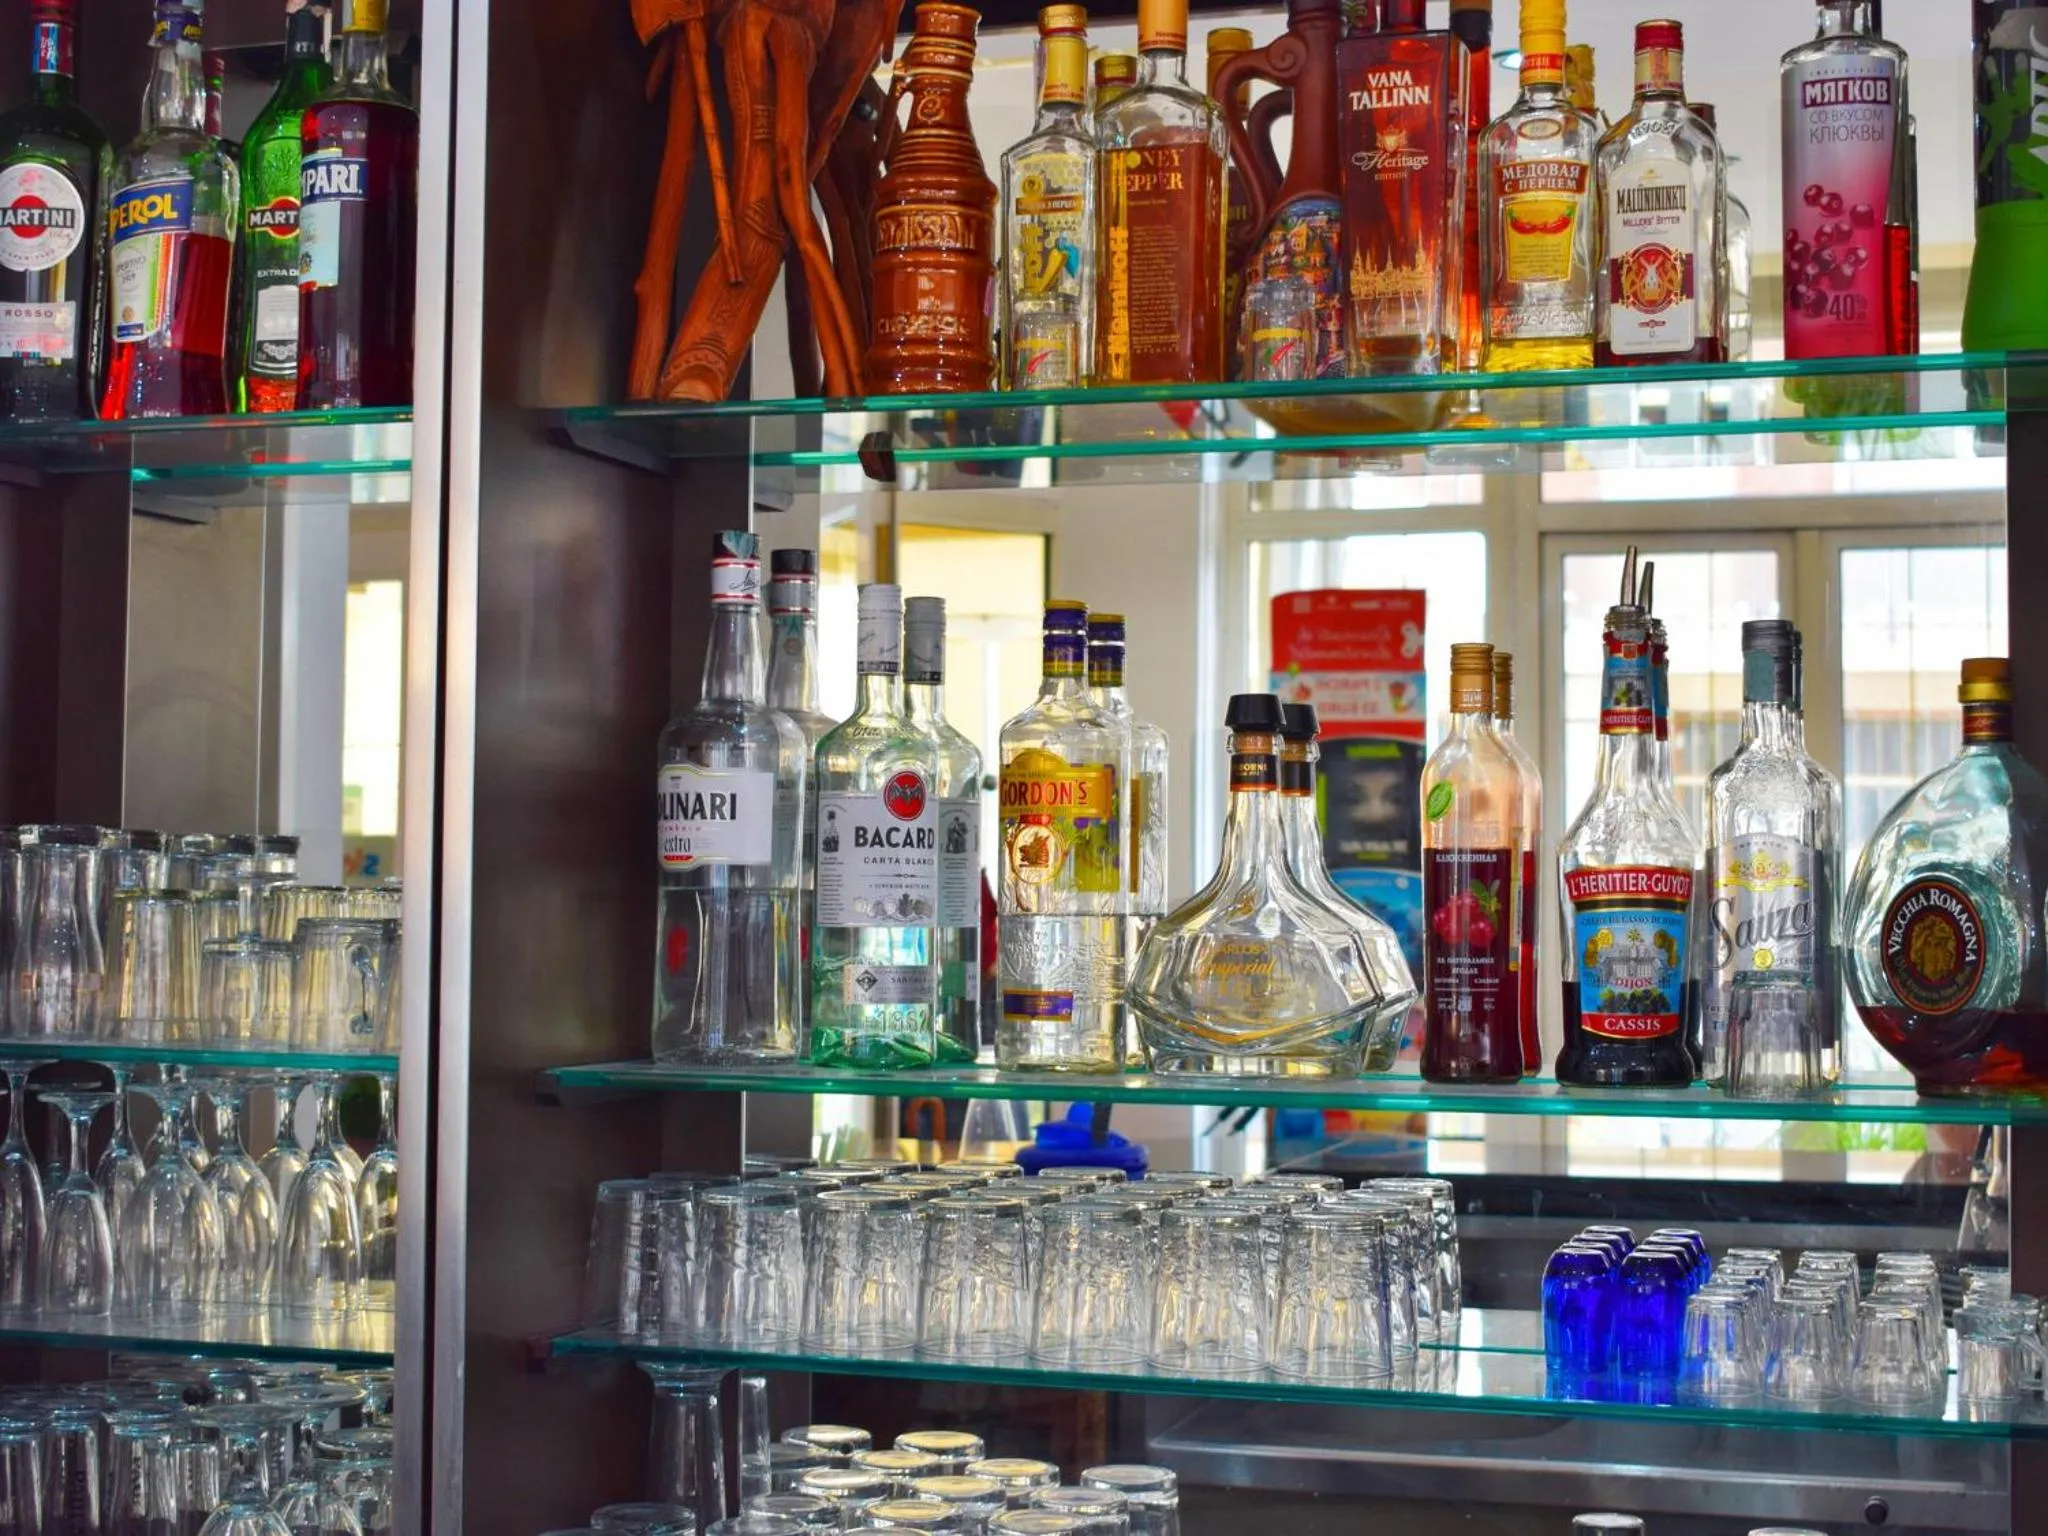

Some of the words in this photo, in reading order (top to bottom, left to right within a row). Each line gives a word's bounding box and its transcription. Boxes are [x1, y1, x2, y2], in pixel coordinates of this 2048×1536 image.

[1368, 70, 1413, 87] VANA
[1349, 86, 1431, 111] TALLINN
[1805, 79, 1888, 105] МЯГКОВ
[1810, 124, 1884, 143] КЛЮКВЫ
[1351, 149, 1429, 171] Heritage
[1502, 162, 1580, 180] МЕДОВАЯ
[1504, 182, 1513, 192] С
[1519, 179, 1577, 190] ПЕРЦЕМ
[1000, 779, 1088, 806] GORDON'S
[863, 856, 901, 866] CARTA
[1709, 896, 1816, 970] Sauza
[1888, 893, 1929, 955] VECCHIA
[1929, 887, 1978, 962] ROMAGNA
[1604, 1018, 1661, 1031] CASSIS
